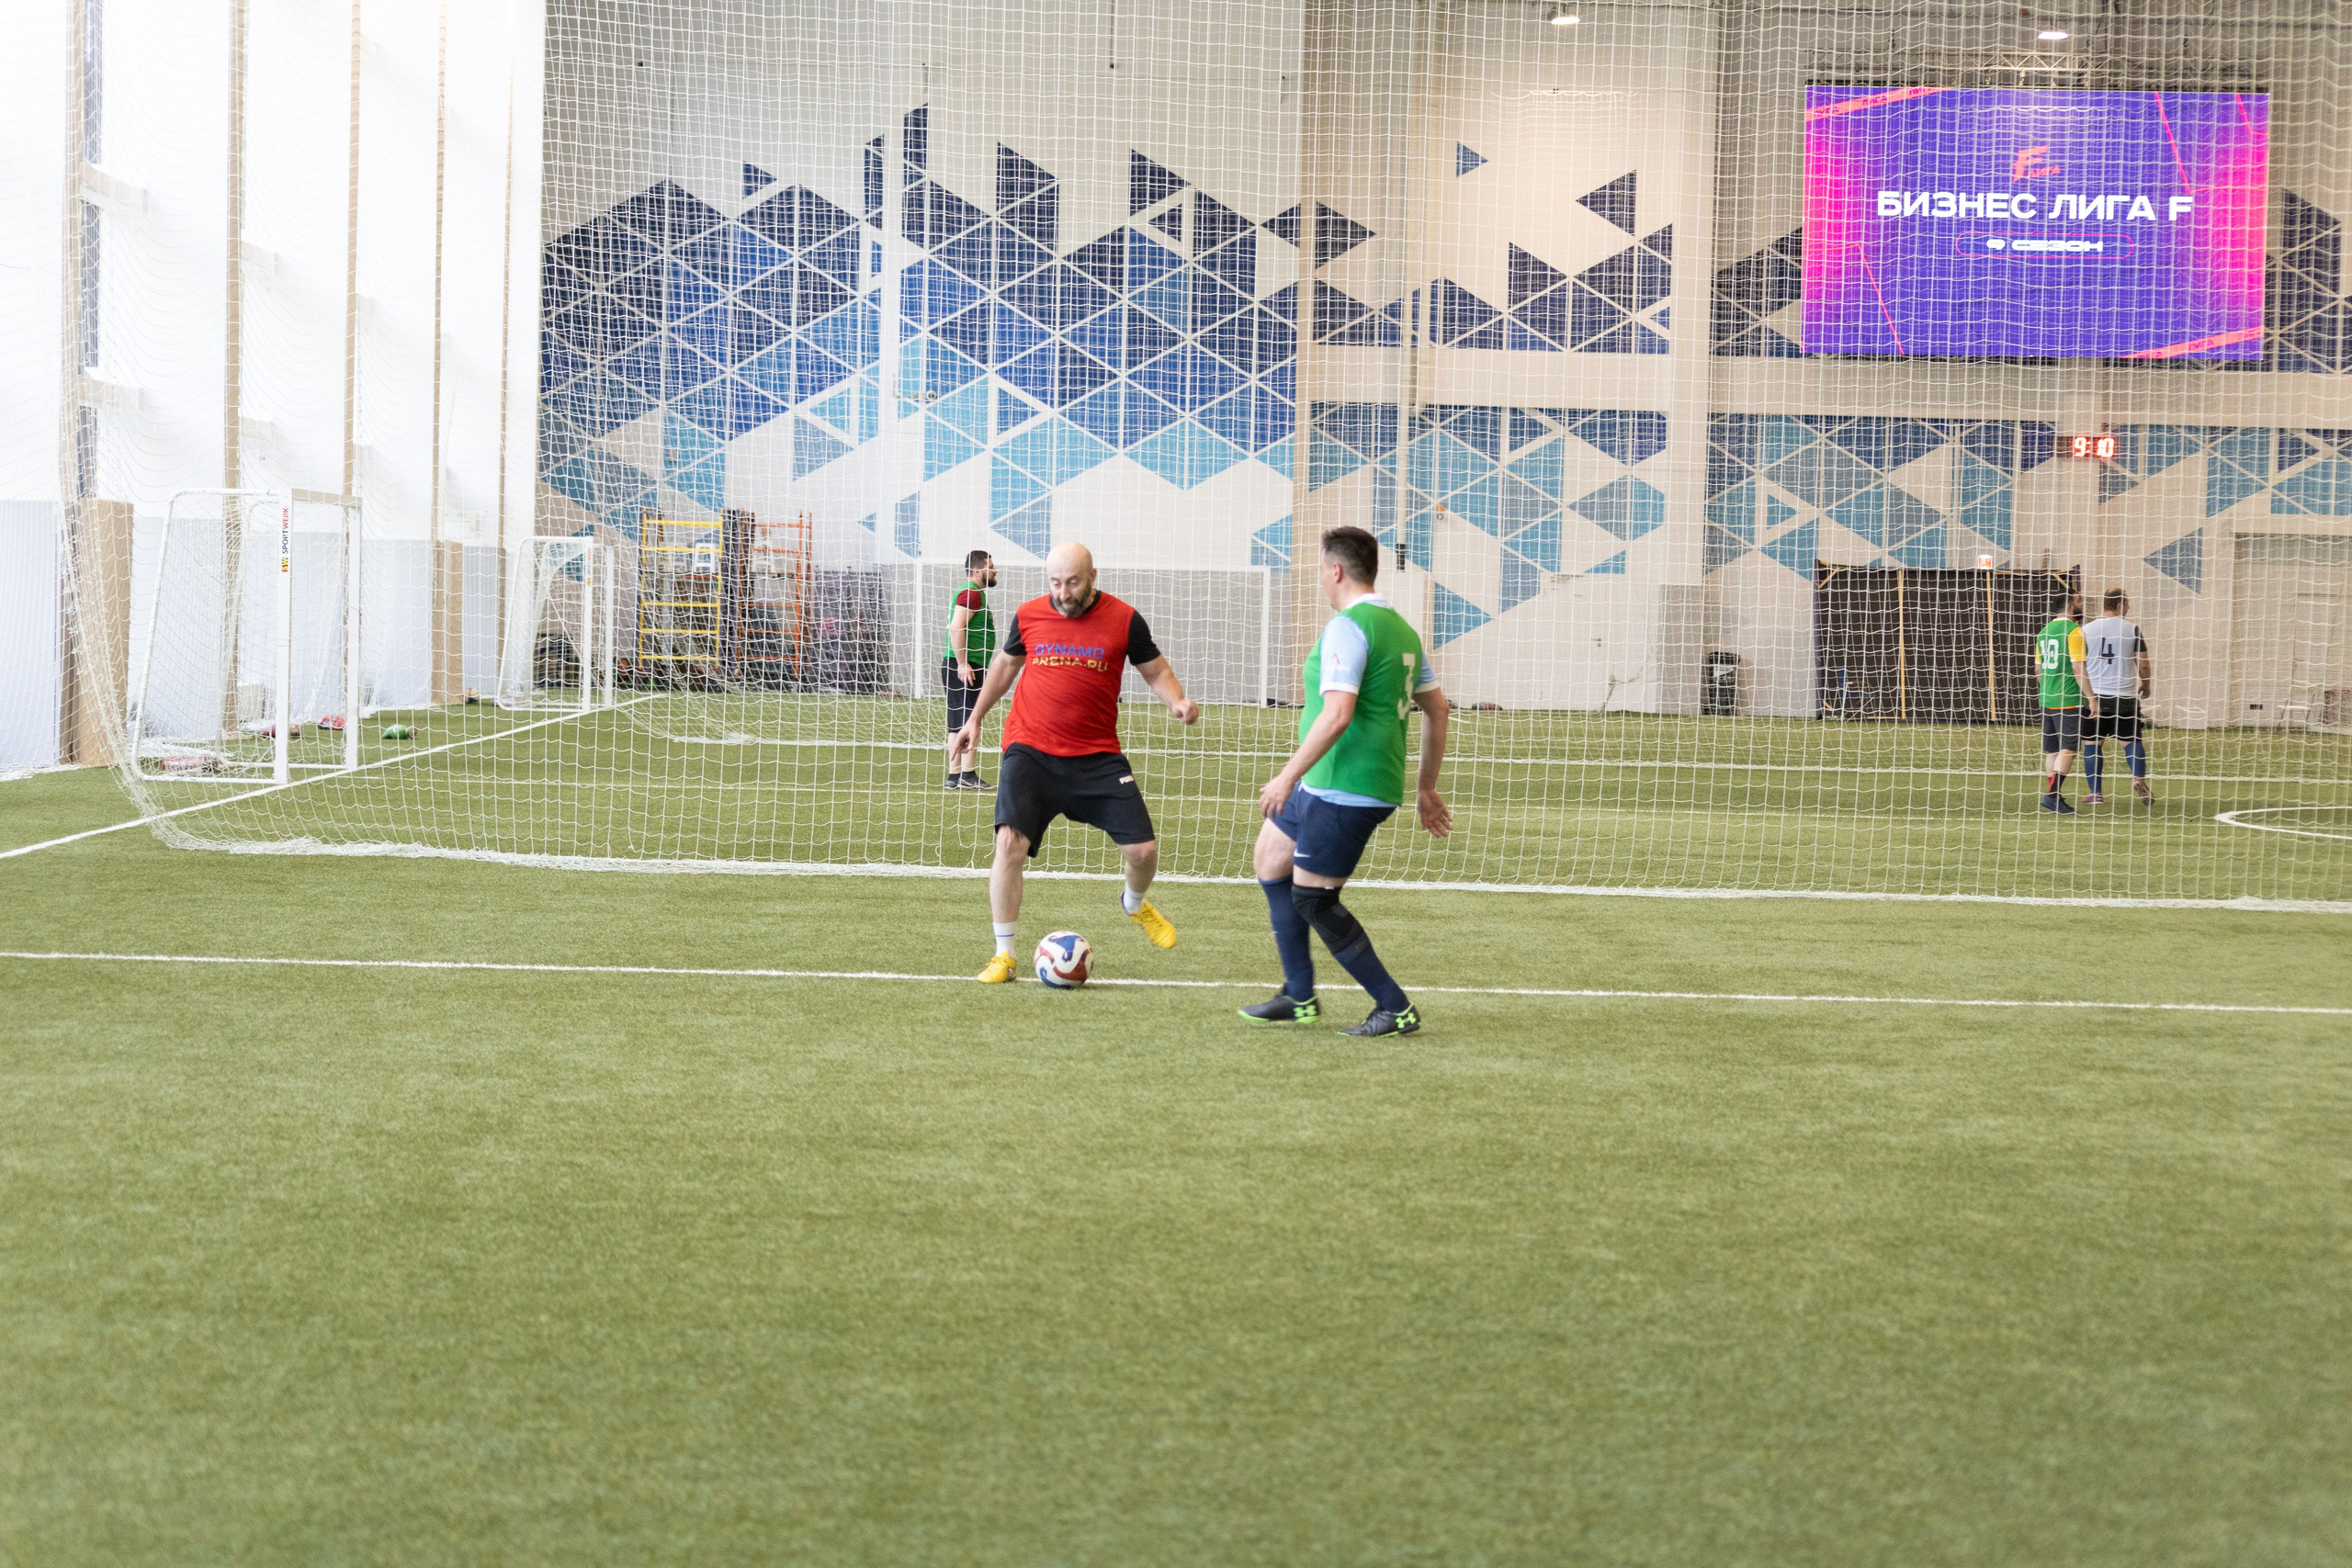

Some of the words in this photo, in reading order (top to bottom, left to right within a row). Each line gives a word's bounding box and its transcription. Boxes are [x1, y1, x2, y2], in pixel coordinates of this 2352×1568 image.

[1877, 191, 2037, 219] БИЗНЕС
[2049, 194, 2157, 221] ЛИГА
[2169, 196, 2193, 221] F
[1986, 239, 2006, 251] 9
[2012, 240, 2104, 252] СЕЗОН
[2075, 437, 2115, 457] 9:10
[1035, 643, 1105, 660] DYNAMO
[2100, 637, 2115, 665] 4
[1032, 656, 1109, 671] ARENA.RU
[1396, 653, 1417, 720] 3
